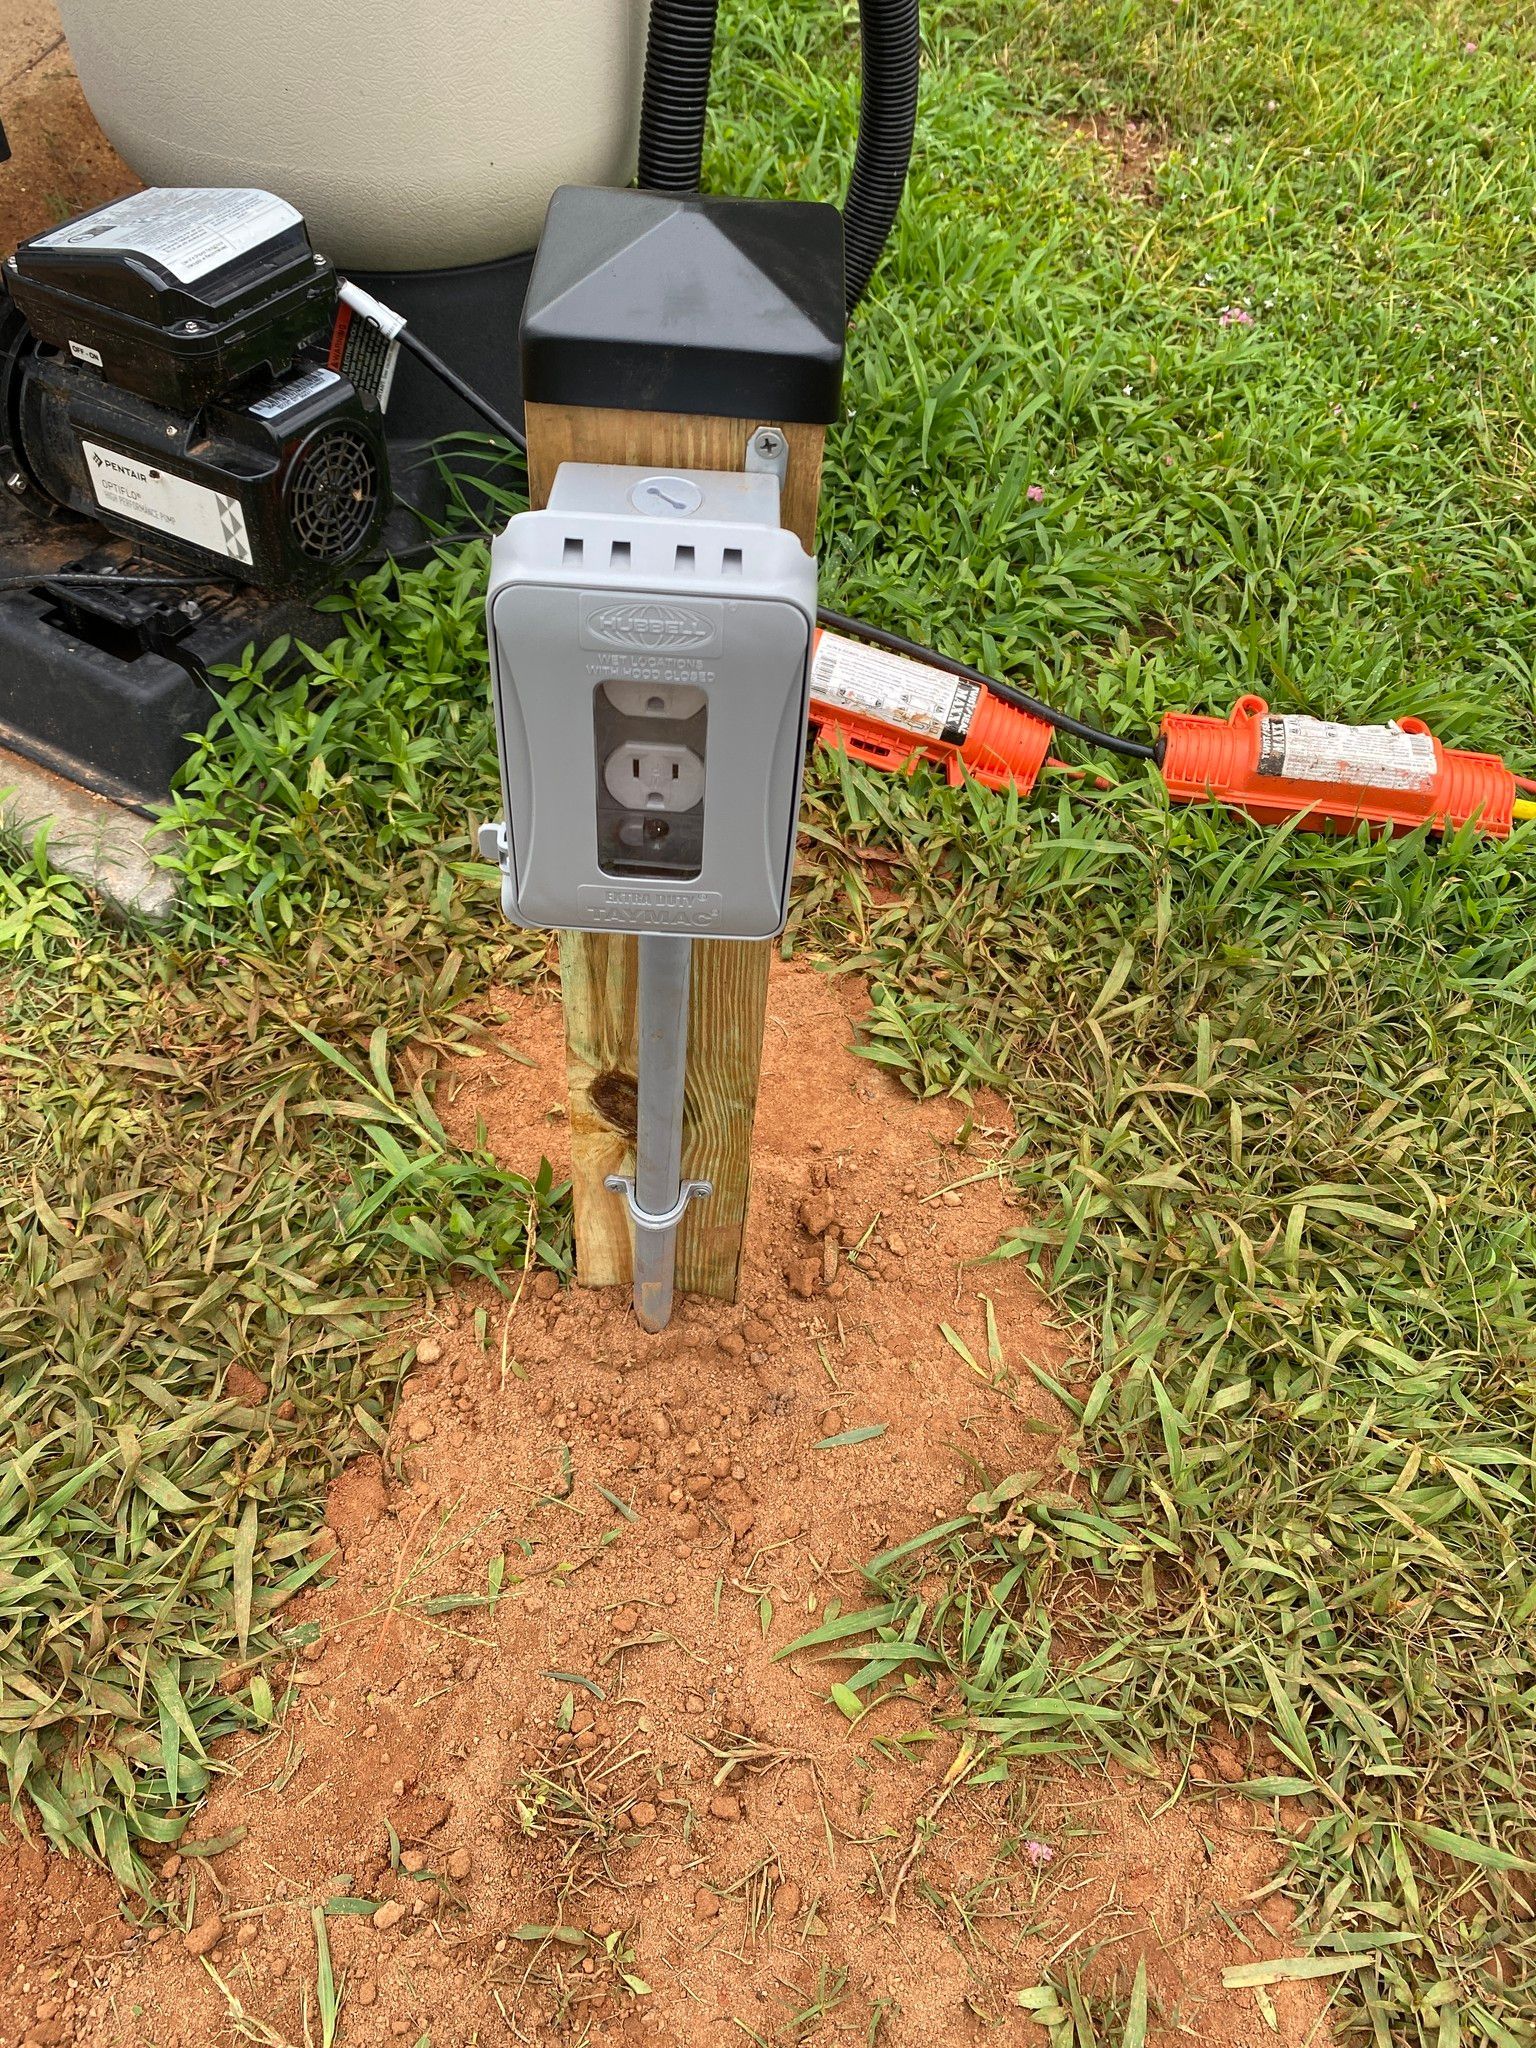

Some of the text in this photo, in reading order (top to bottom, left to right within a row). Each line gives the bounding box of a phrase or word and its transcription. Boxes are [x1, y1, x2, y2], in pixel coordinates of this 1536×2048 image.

[104, 460, 148, 483] PENTAIR
[599, 614, 706, 637] HUBBELL
[598, 654, 704, 670] WET LOCATIONS
[586, 664, 619, 675] WITH
[664, 669, 716, 683] CLOSED
